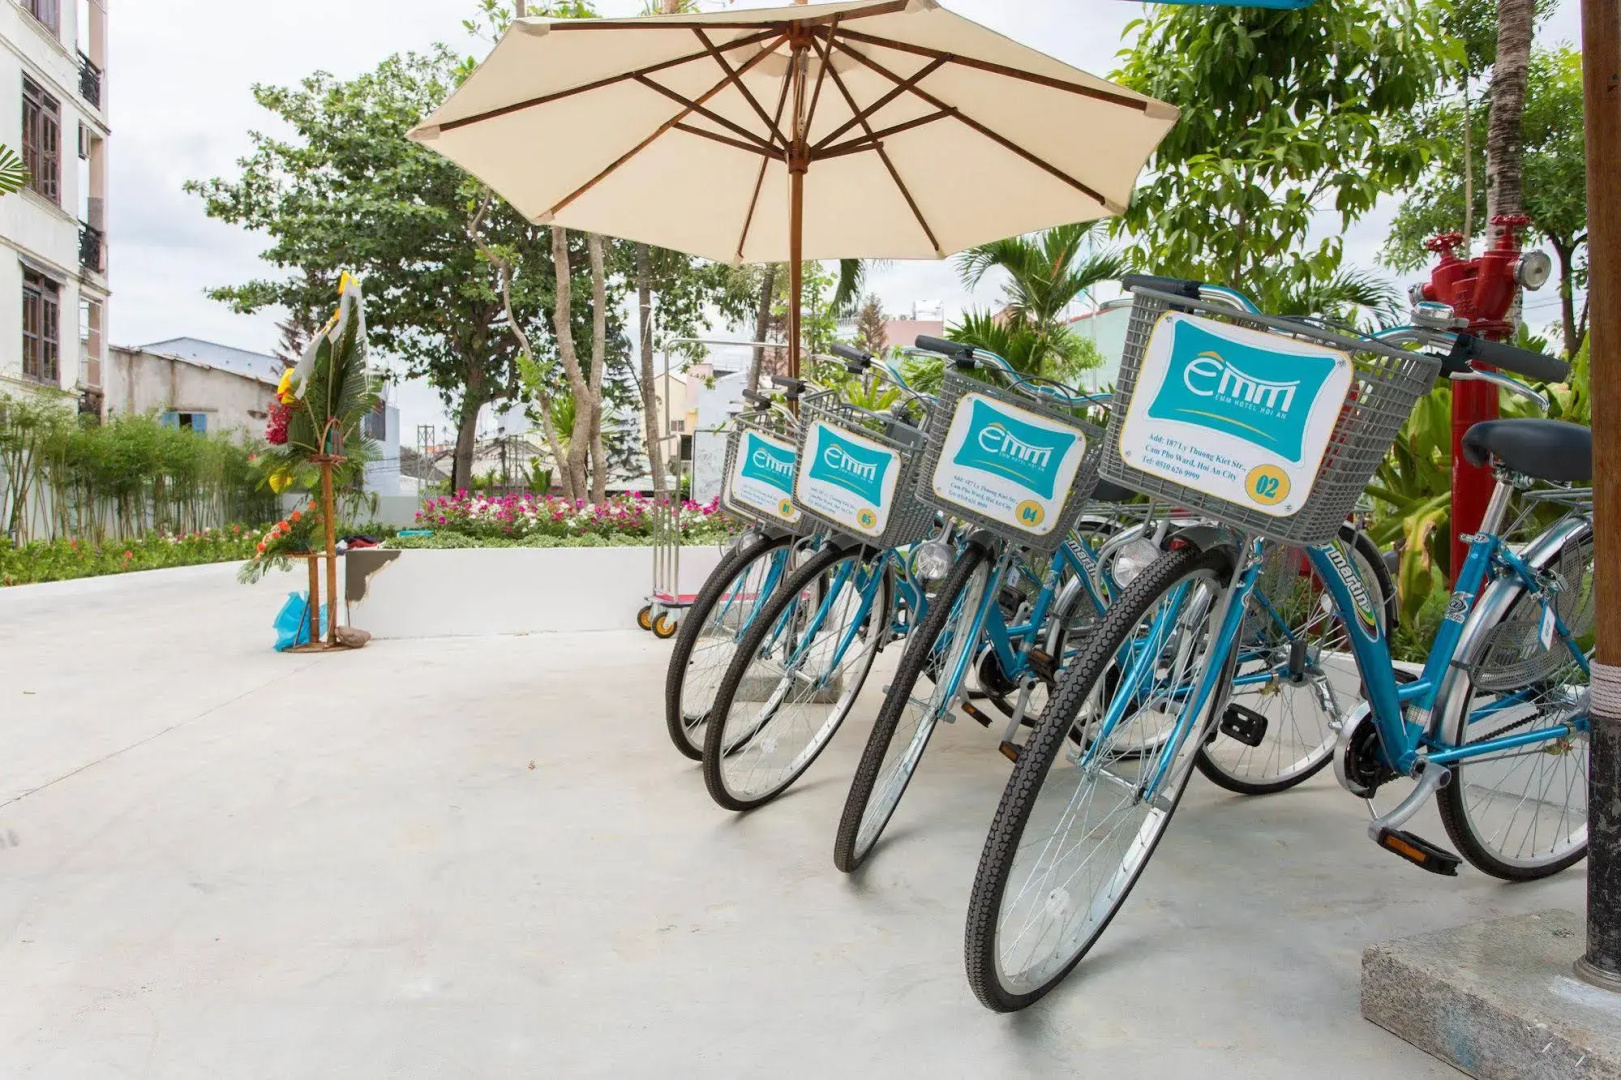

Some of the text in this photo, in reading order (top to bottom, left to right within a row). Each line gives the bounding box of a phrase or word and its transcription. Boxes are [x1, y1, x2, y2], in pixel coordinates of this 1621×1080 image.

[1214, 394, 1287, 420] EMM HOTEL HOI AN
[1142, 455, 1155, 465] Tel:
[1149, 433, 1164, 444] Add:
[1166, 438, 1178, 447] 187
[1178, 442, 1187, 452] Ly
[1189, 445, 1215, 461] Thuong
[1216, 454, 1231, 466] Kiet
[1145, 445, 1237, 482] Cam Pho Ward, Hoi An City
[1255, 474, 1280, 498] 02
[782, 503, 790, 513] 01
[862, 513, 872, 525] 05
[1022, 507, 1037, 522] 04
[1329, 550, 1370, 607] martin
